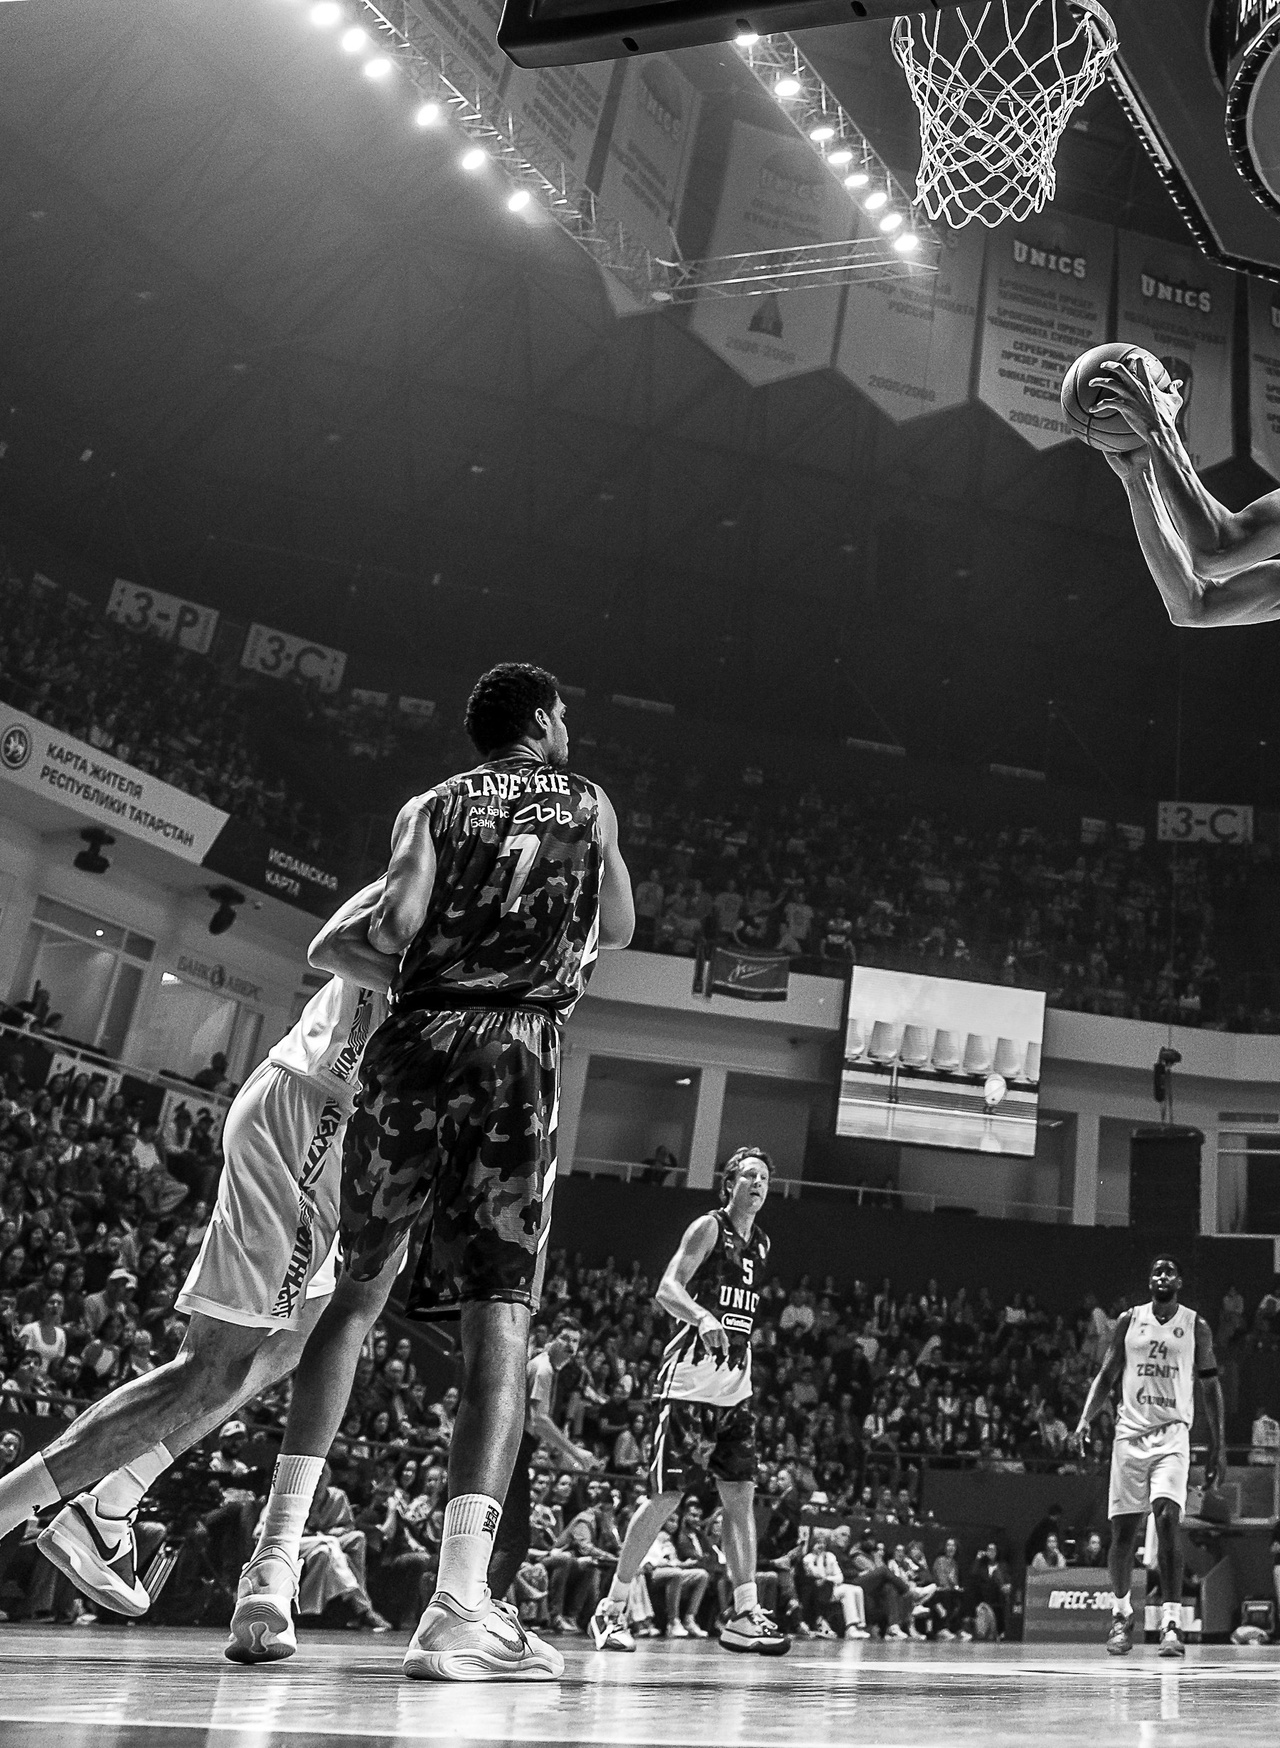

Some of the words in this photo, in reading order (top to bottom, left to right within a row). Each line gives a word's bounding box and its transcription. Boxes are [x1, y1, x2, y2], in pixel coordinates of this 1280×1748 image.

[1013, 239, 1087, 278] UNICS
[1141, 273, 1212, 313] UNICS
[46, 743, 89, 775] КАРТА
[89, 763, 144, 799] ЖИТЕЛЯ
[39, 764, 127, 816] РЕСПУБЛИКИ
[128, 803, 196, 847] ТАТАРСТАН
[497, 833, 542, 918] 7
[742, 1257, 754, 1286] 5
[719, 1285, 761, 1313] UNIC
[1148, 1339, 1168, 1360] 24
[1136, 1363, 1180, 1380] ZENIT
